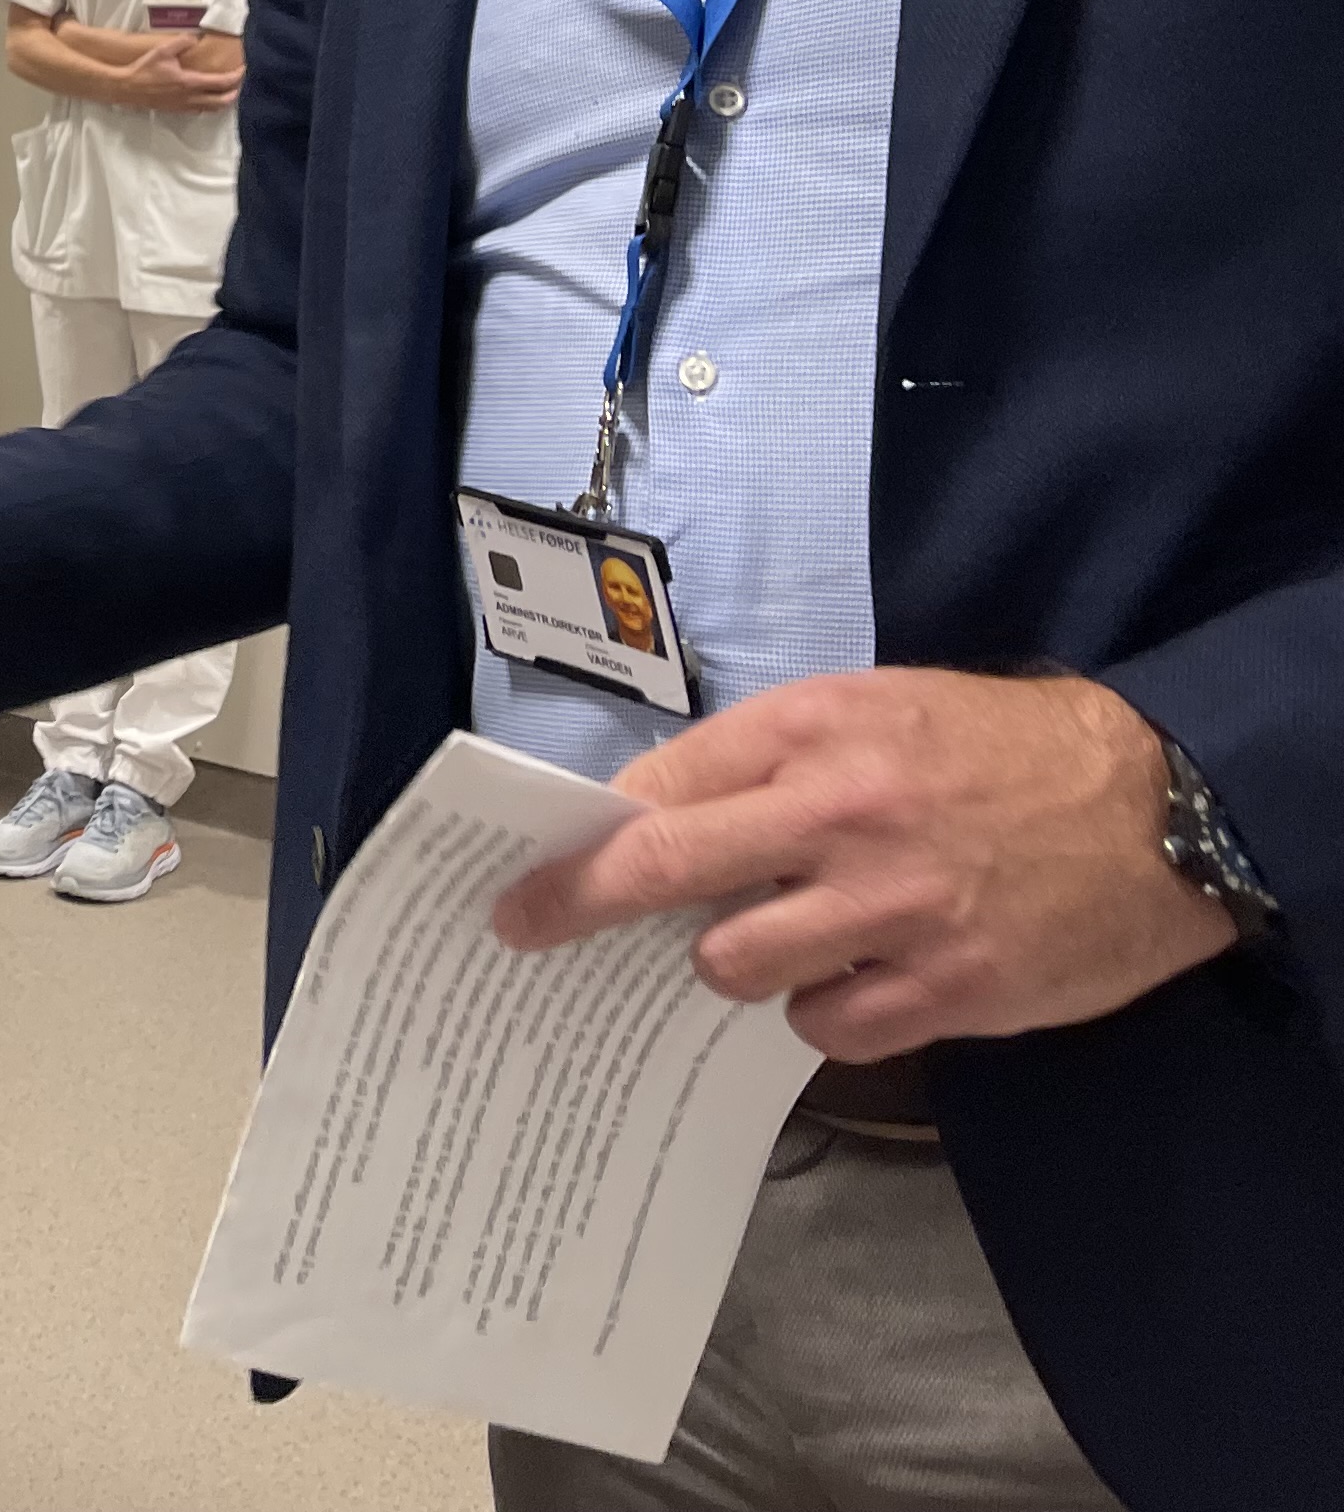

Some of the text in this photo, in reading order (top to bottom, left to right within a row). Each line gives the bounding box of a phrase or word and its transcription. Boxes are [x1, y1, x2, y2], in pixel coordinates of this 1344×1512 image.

[497, 518, 584, 556] HELSE FØRDE
[586, 651, 633, 677] VARDEN
